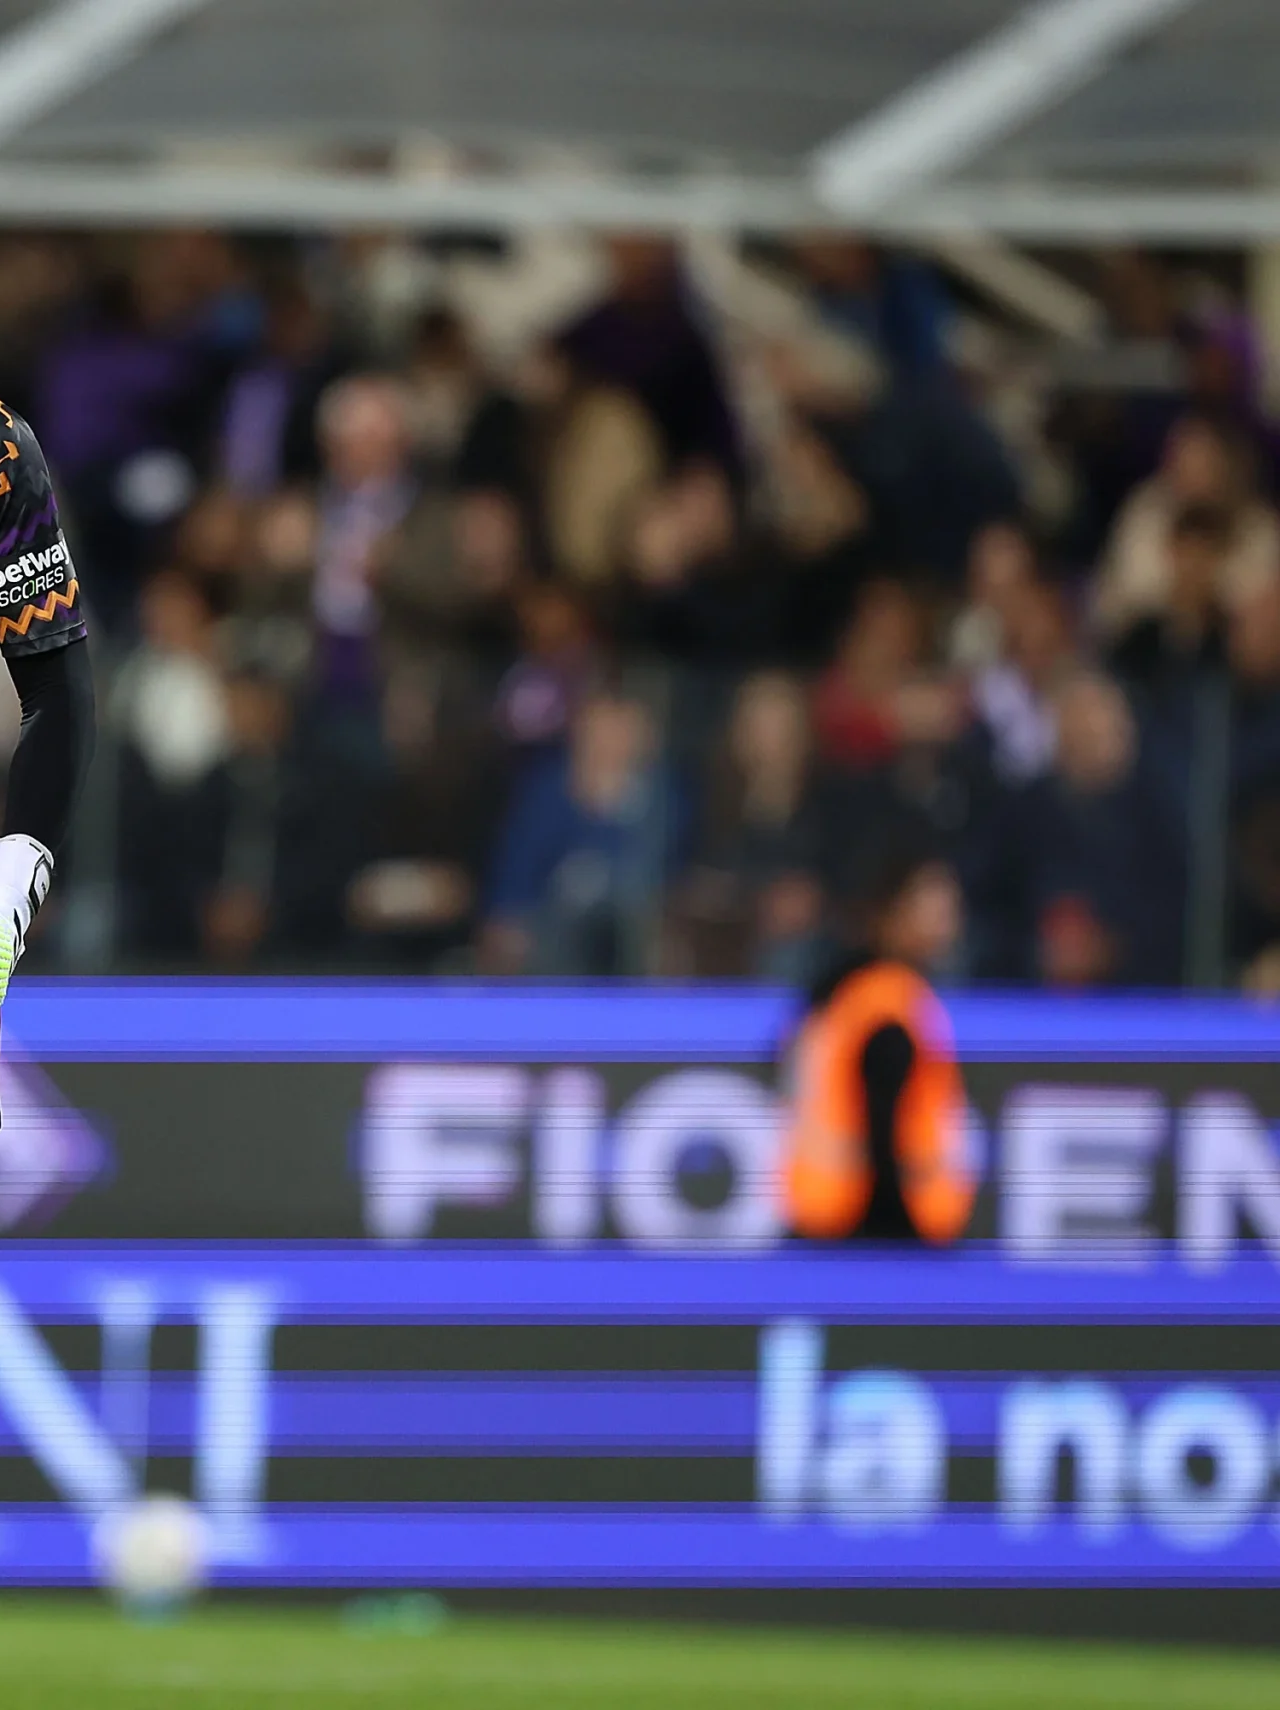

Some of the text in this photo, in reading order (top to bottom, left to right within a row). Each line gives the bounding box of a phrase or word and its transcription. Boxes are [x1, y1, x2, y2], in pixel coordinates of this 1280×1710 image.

[356, 1058, 1280, 1276] FIOEN
[754, 1316, 1280, 1554] la no
